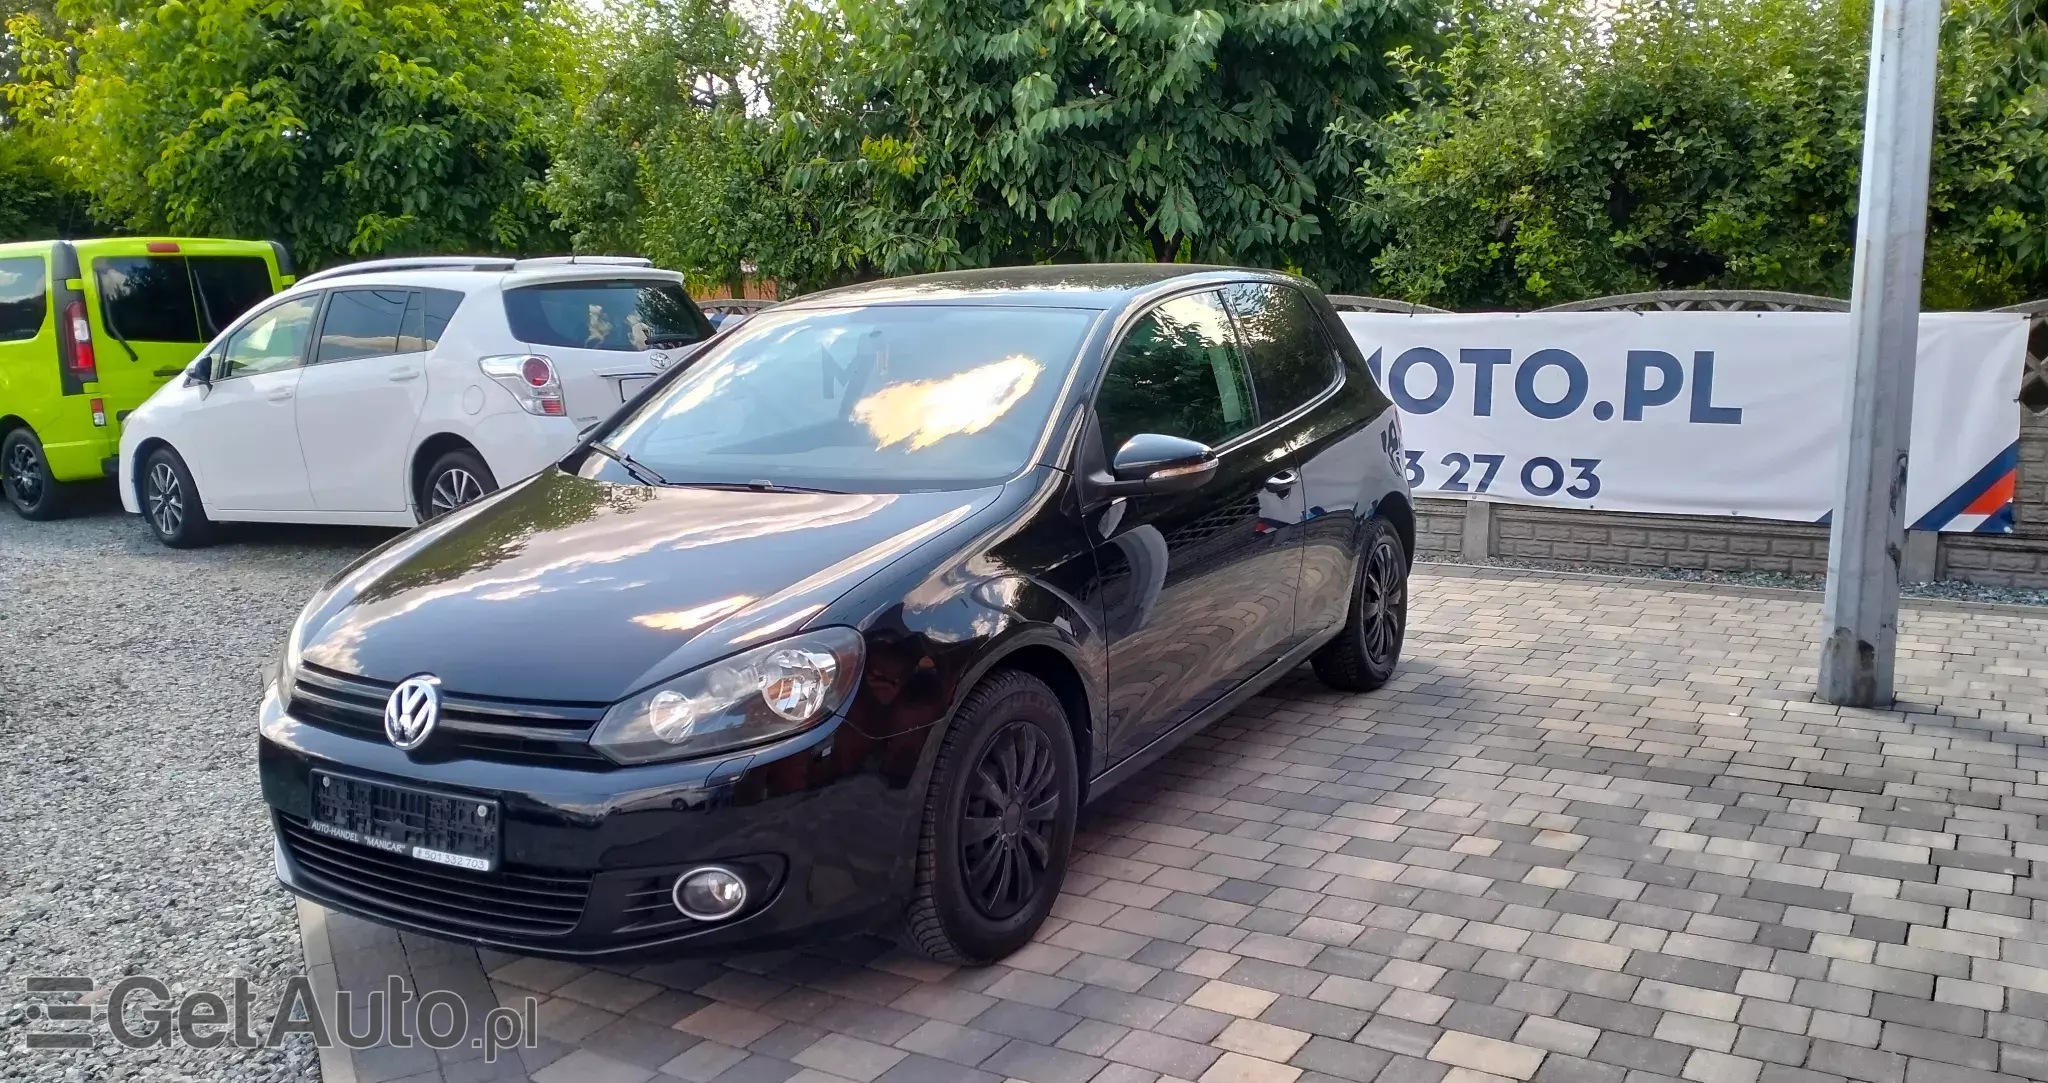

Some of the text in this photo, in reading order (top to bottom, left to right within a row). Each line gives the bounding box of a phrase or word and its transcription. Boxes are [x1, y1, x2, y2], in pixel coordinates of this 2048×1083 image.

[1440, 452, 1506, 493] 27
[1520, 456, 1603, 499] 03
[311, 820, 359, 843] AUTO-HANDEL
[424, 850, 485, 869] 501 332 703
